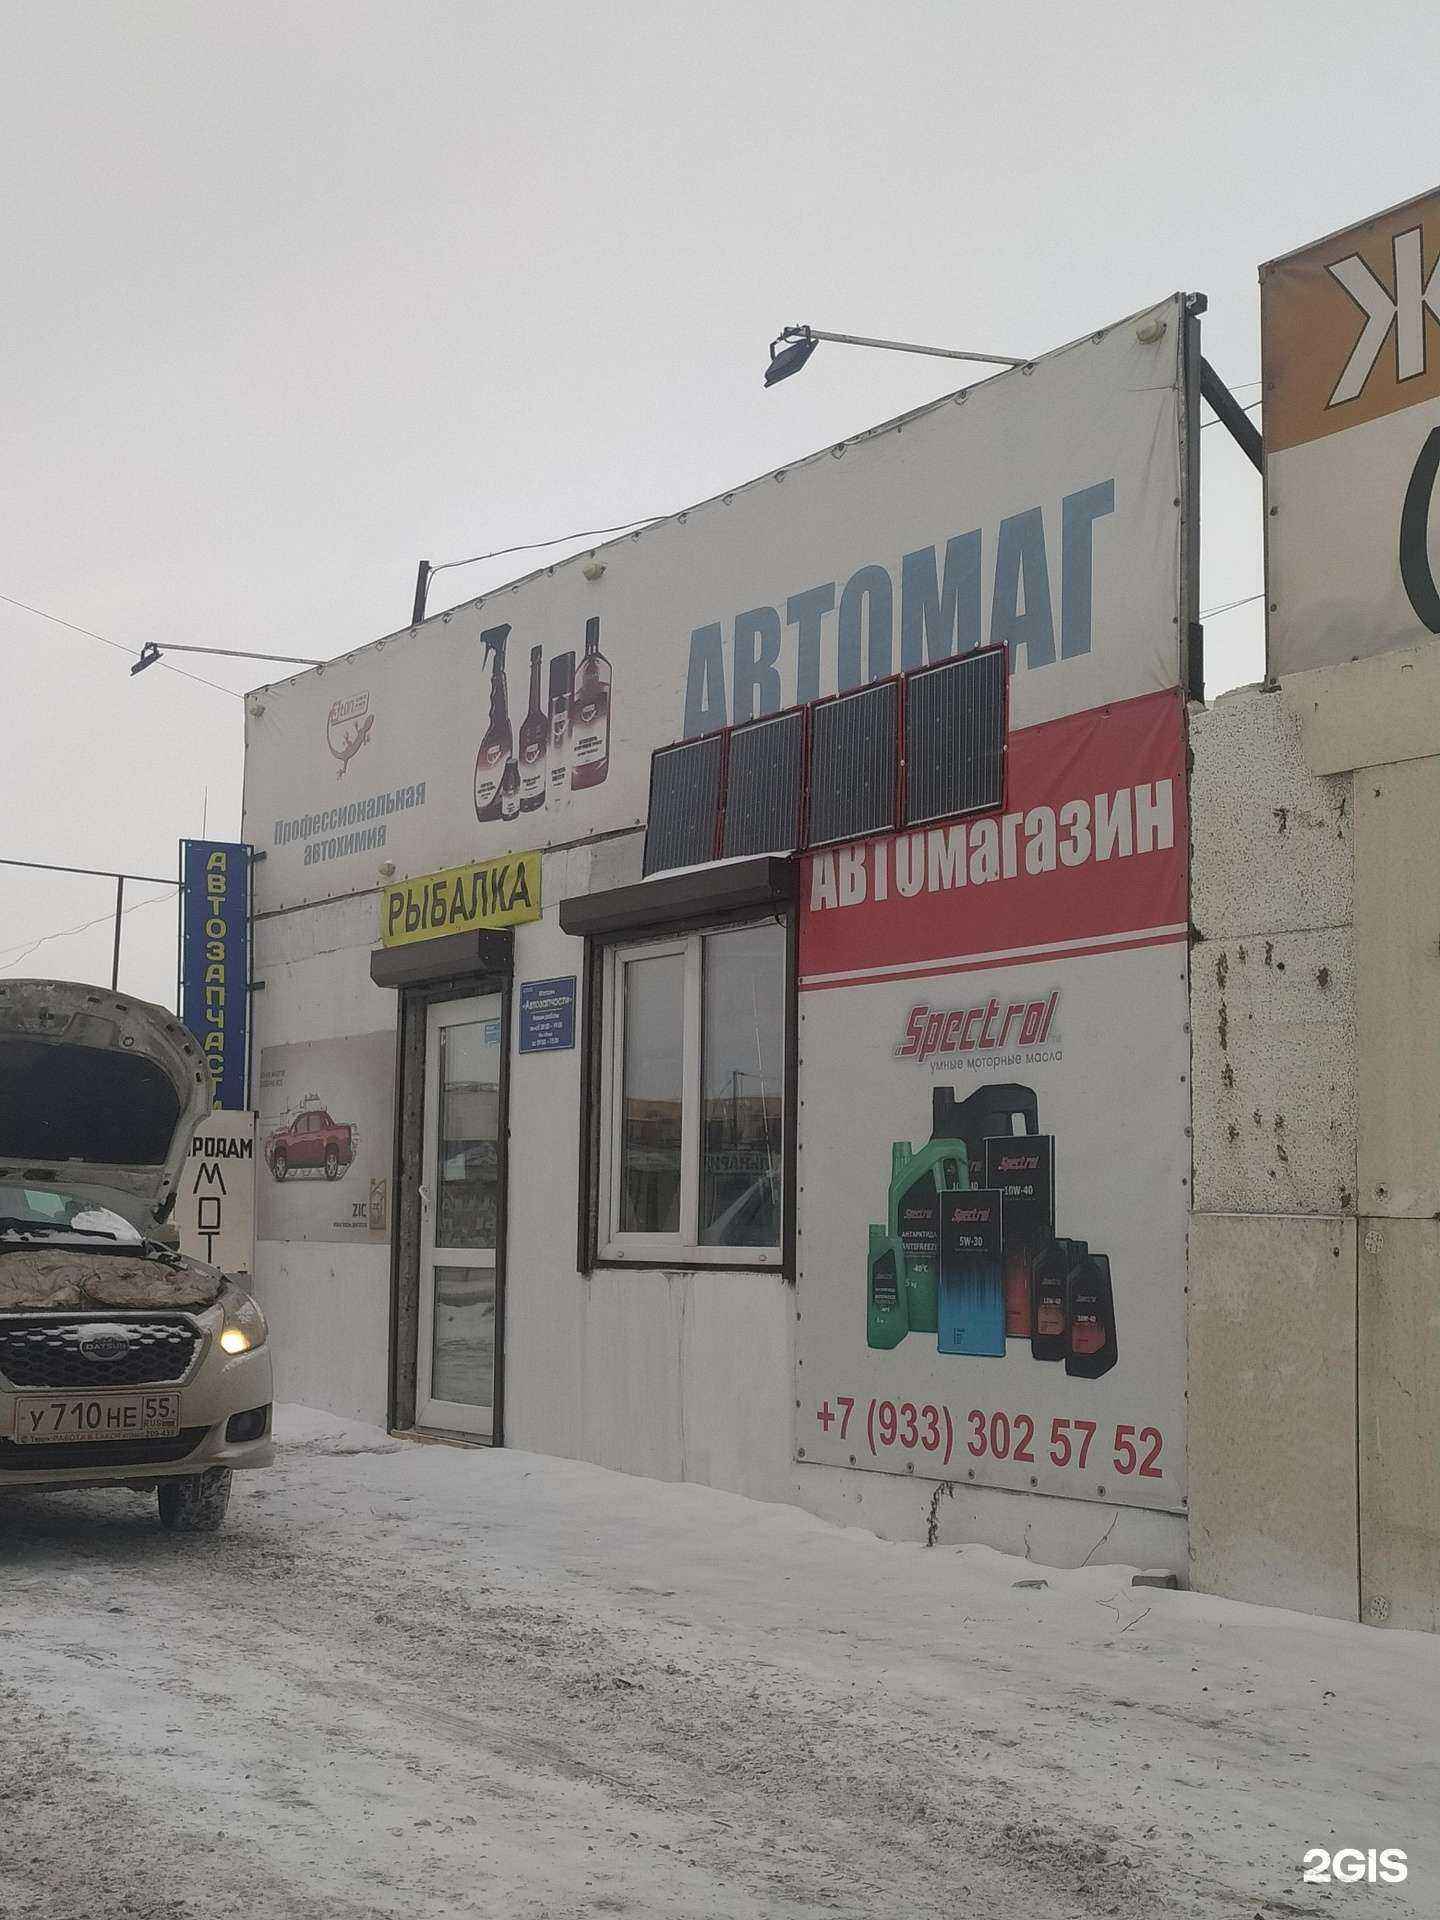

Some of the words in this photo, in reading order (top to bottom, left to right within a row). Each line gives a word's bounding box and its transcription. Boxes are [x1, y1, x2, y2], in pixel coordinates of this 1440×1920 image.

[681, 478, 1115, 742] АВТОМАГ
[273, 781, 426, 846] Профессиональная
[304, 824, 387, 866] автохимия
[388, 860, 532, 937] РЫБАЛКА
[896, 991, 1059, 1063] Spectrol
[930, 1057, 964, 1076] умные
[966, 1053, 1022, 1073] моторные
[1026, 1049, 1063, 1063] масла
[187, 1136, 253, 1159] РОДАМ
[1003, 1184, 1034, 1196] 10W-40
[352, 1203, 367, 1218] ZIC
[959, 1236, 984, 1248] 5W-30
[146, 1397, 170, 1419] 55
[817, 1396, 855, 1441] +7
[867, 1398, 954, 1466] (933)
[967, 1408, 1035, 1463] 302
[1049, 1417, 1097, 1469] 57
[1112, 1424, 1163, 1478] 52
